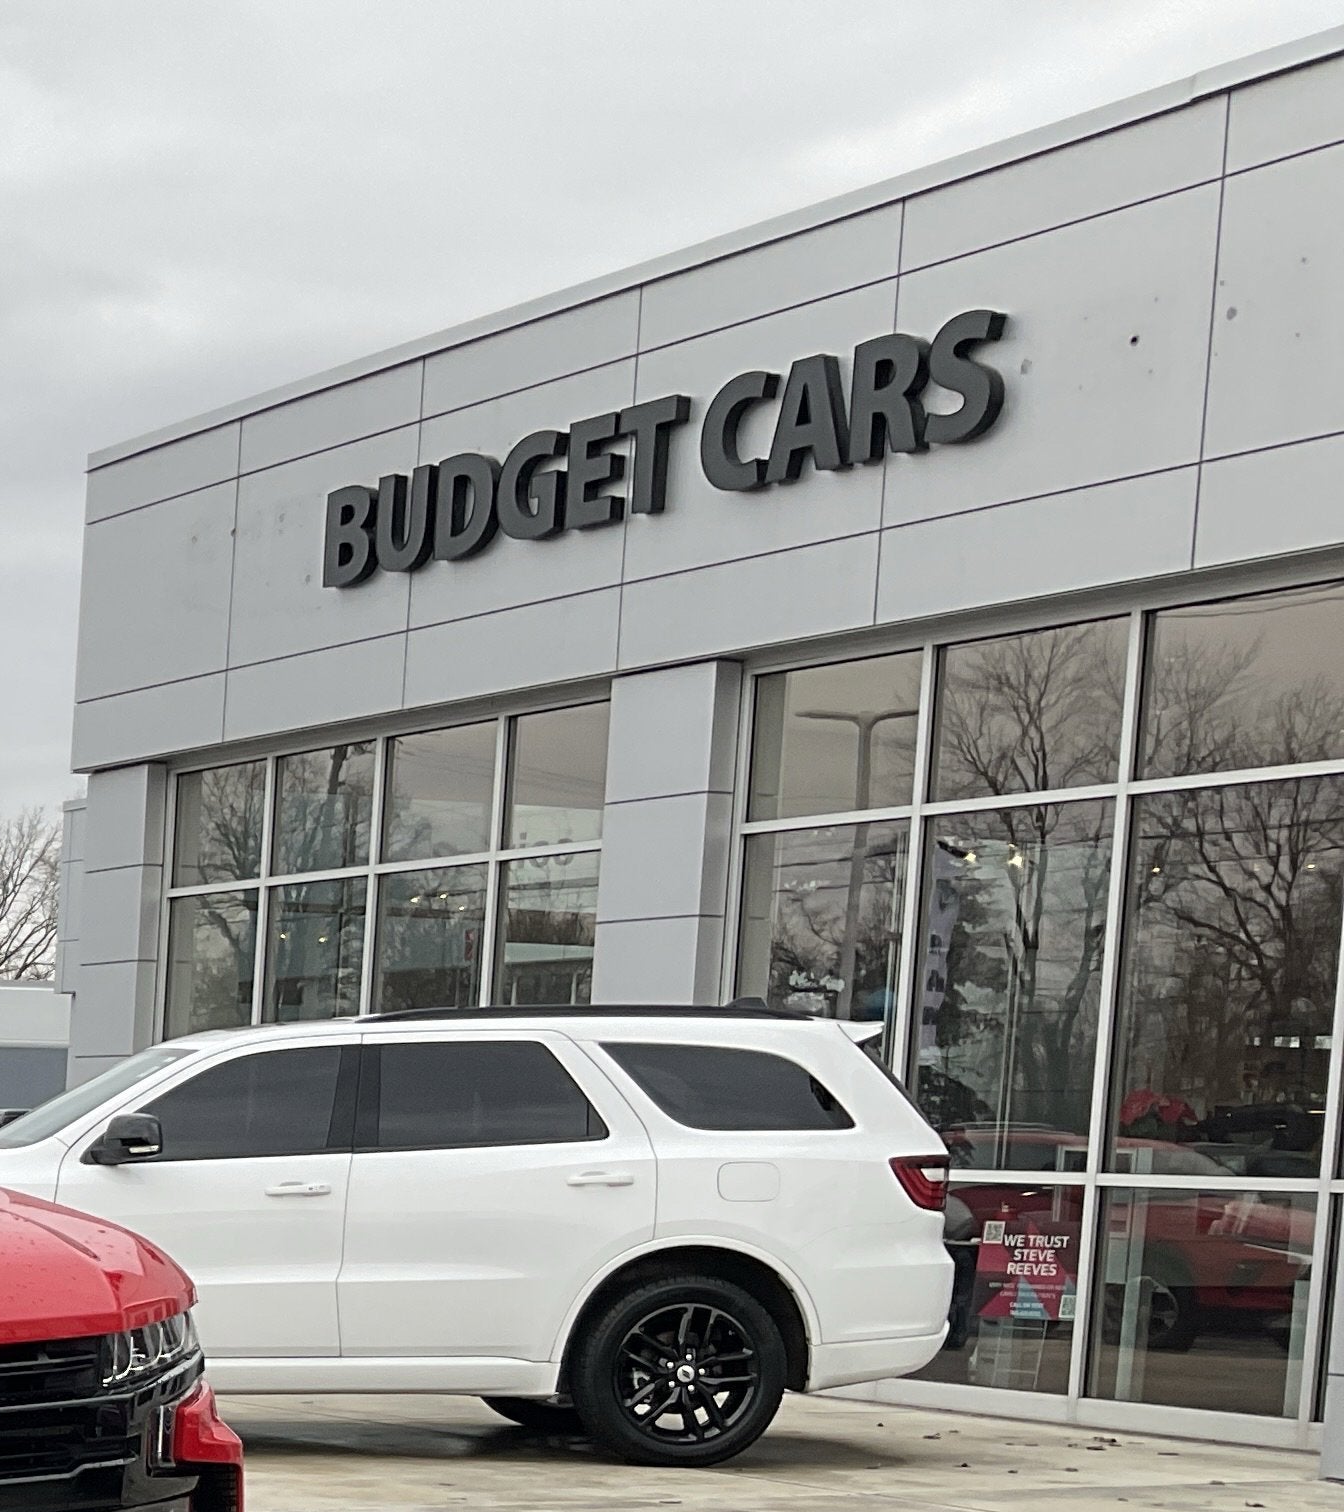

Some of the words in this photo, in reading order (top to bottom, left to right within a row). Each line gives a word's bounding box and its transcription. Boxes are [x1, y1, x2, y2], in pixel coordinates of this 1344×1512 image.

[323, 394, 691, 588] BUDGET
[700, 309, 1009, 491] CARS
[1004, 1234, 1025, 1247] WE
[1027, 1234, 1070, 1249] TRUST
[1013, 1248, 1056, 1262] STEVE
[1006, 1262, 1058, 1276] REEVES
